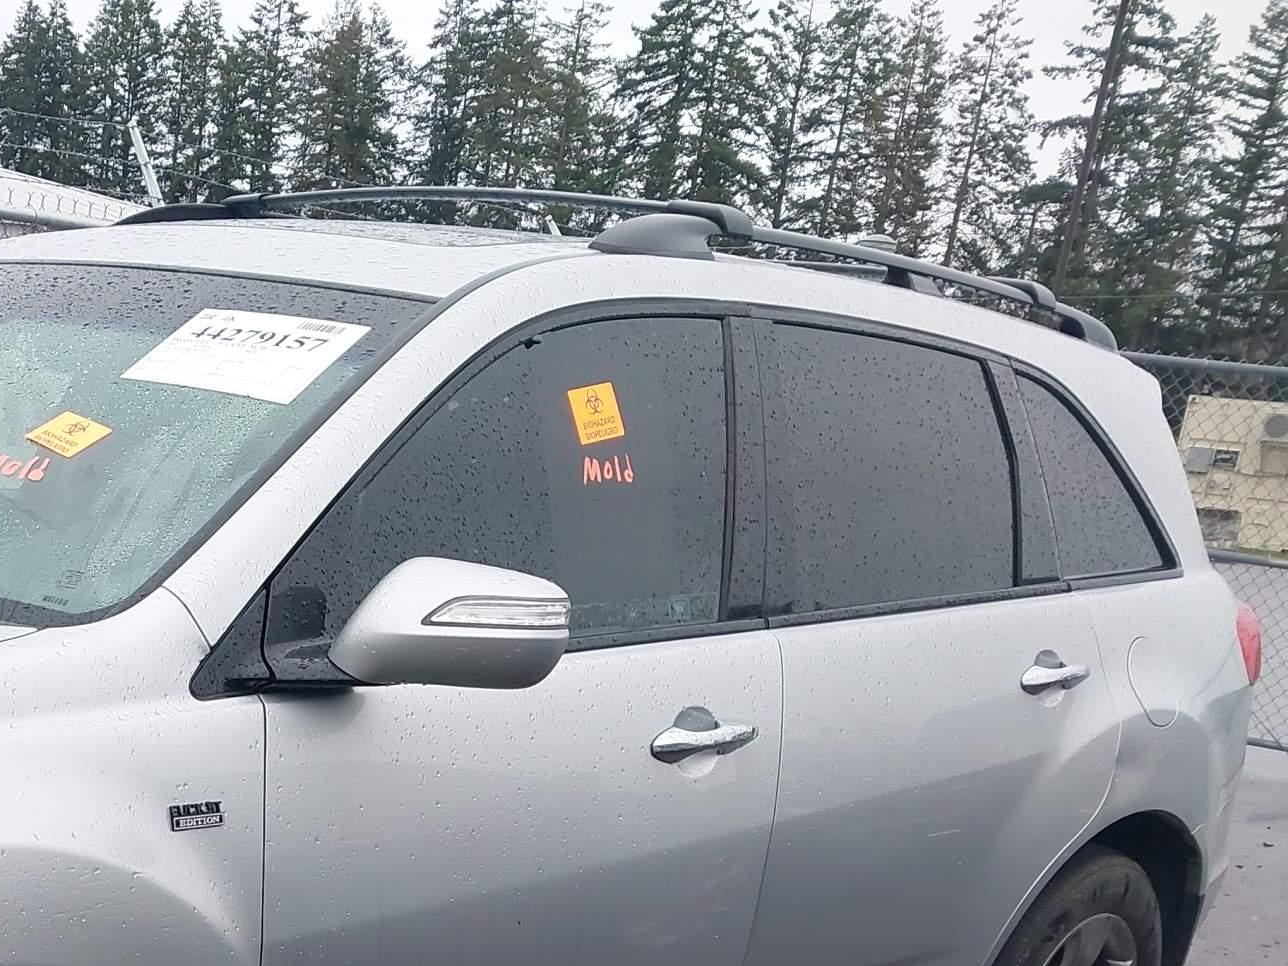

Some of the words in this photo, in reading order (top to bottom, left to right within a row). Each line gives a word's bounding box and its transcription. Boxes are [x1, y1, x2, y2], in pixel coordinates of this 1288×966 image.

[191, 326, 331, 352] 44279157
[583, 415, 616, 430] BIOHAZARD
[583, 453, 634, 486] Mold
[179, 816, 221, 828] EDITION
